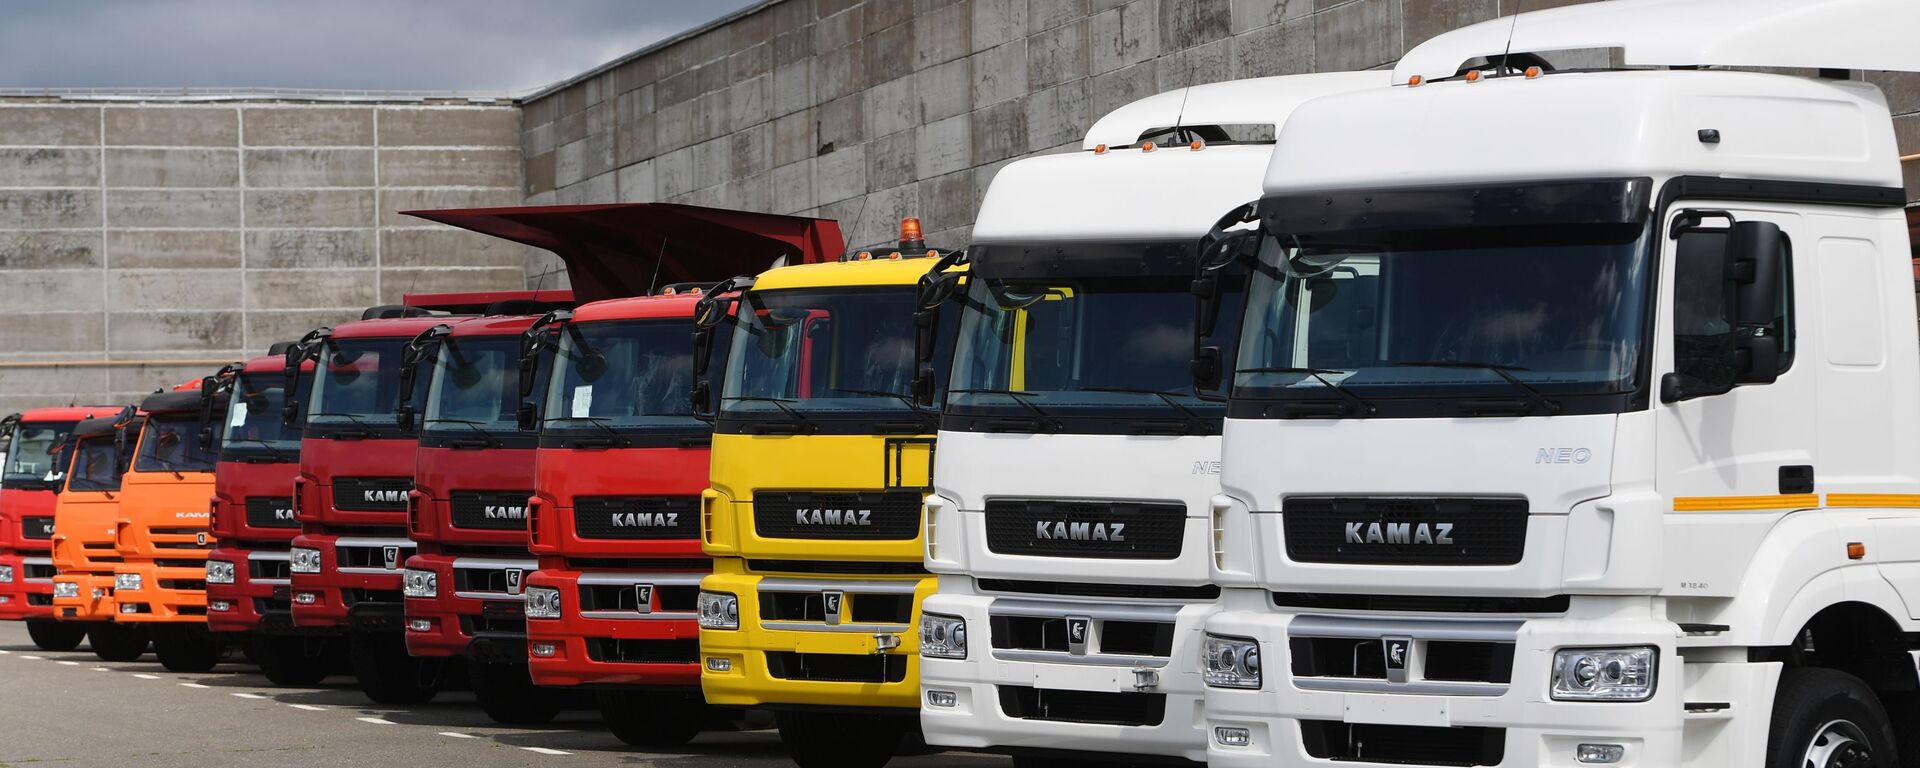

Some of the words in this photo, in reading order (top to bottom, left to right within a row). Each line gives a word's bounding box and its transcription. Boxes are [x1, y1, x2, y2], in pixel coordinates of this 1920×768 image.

[1535, 447, 1592, 464] NEO
[612, 512, 678, 527] KAMAZ
[795, 508, 872, 526] KAMAZ
[1036, 520, 1125, 541] KAMAZ
[1345, 522, 1454, 544] KAMAZ
